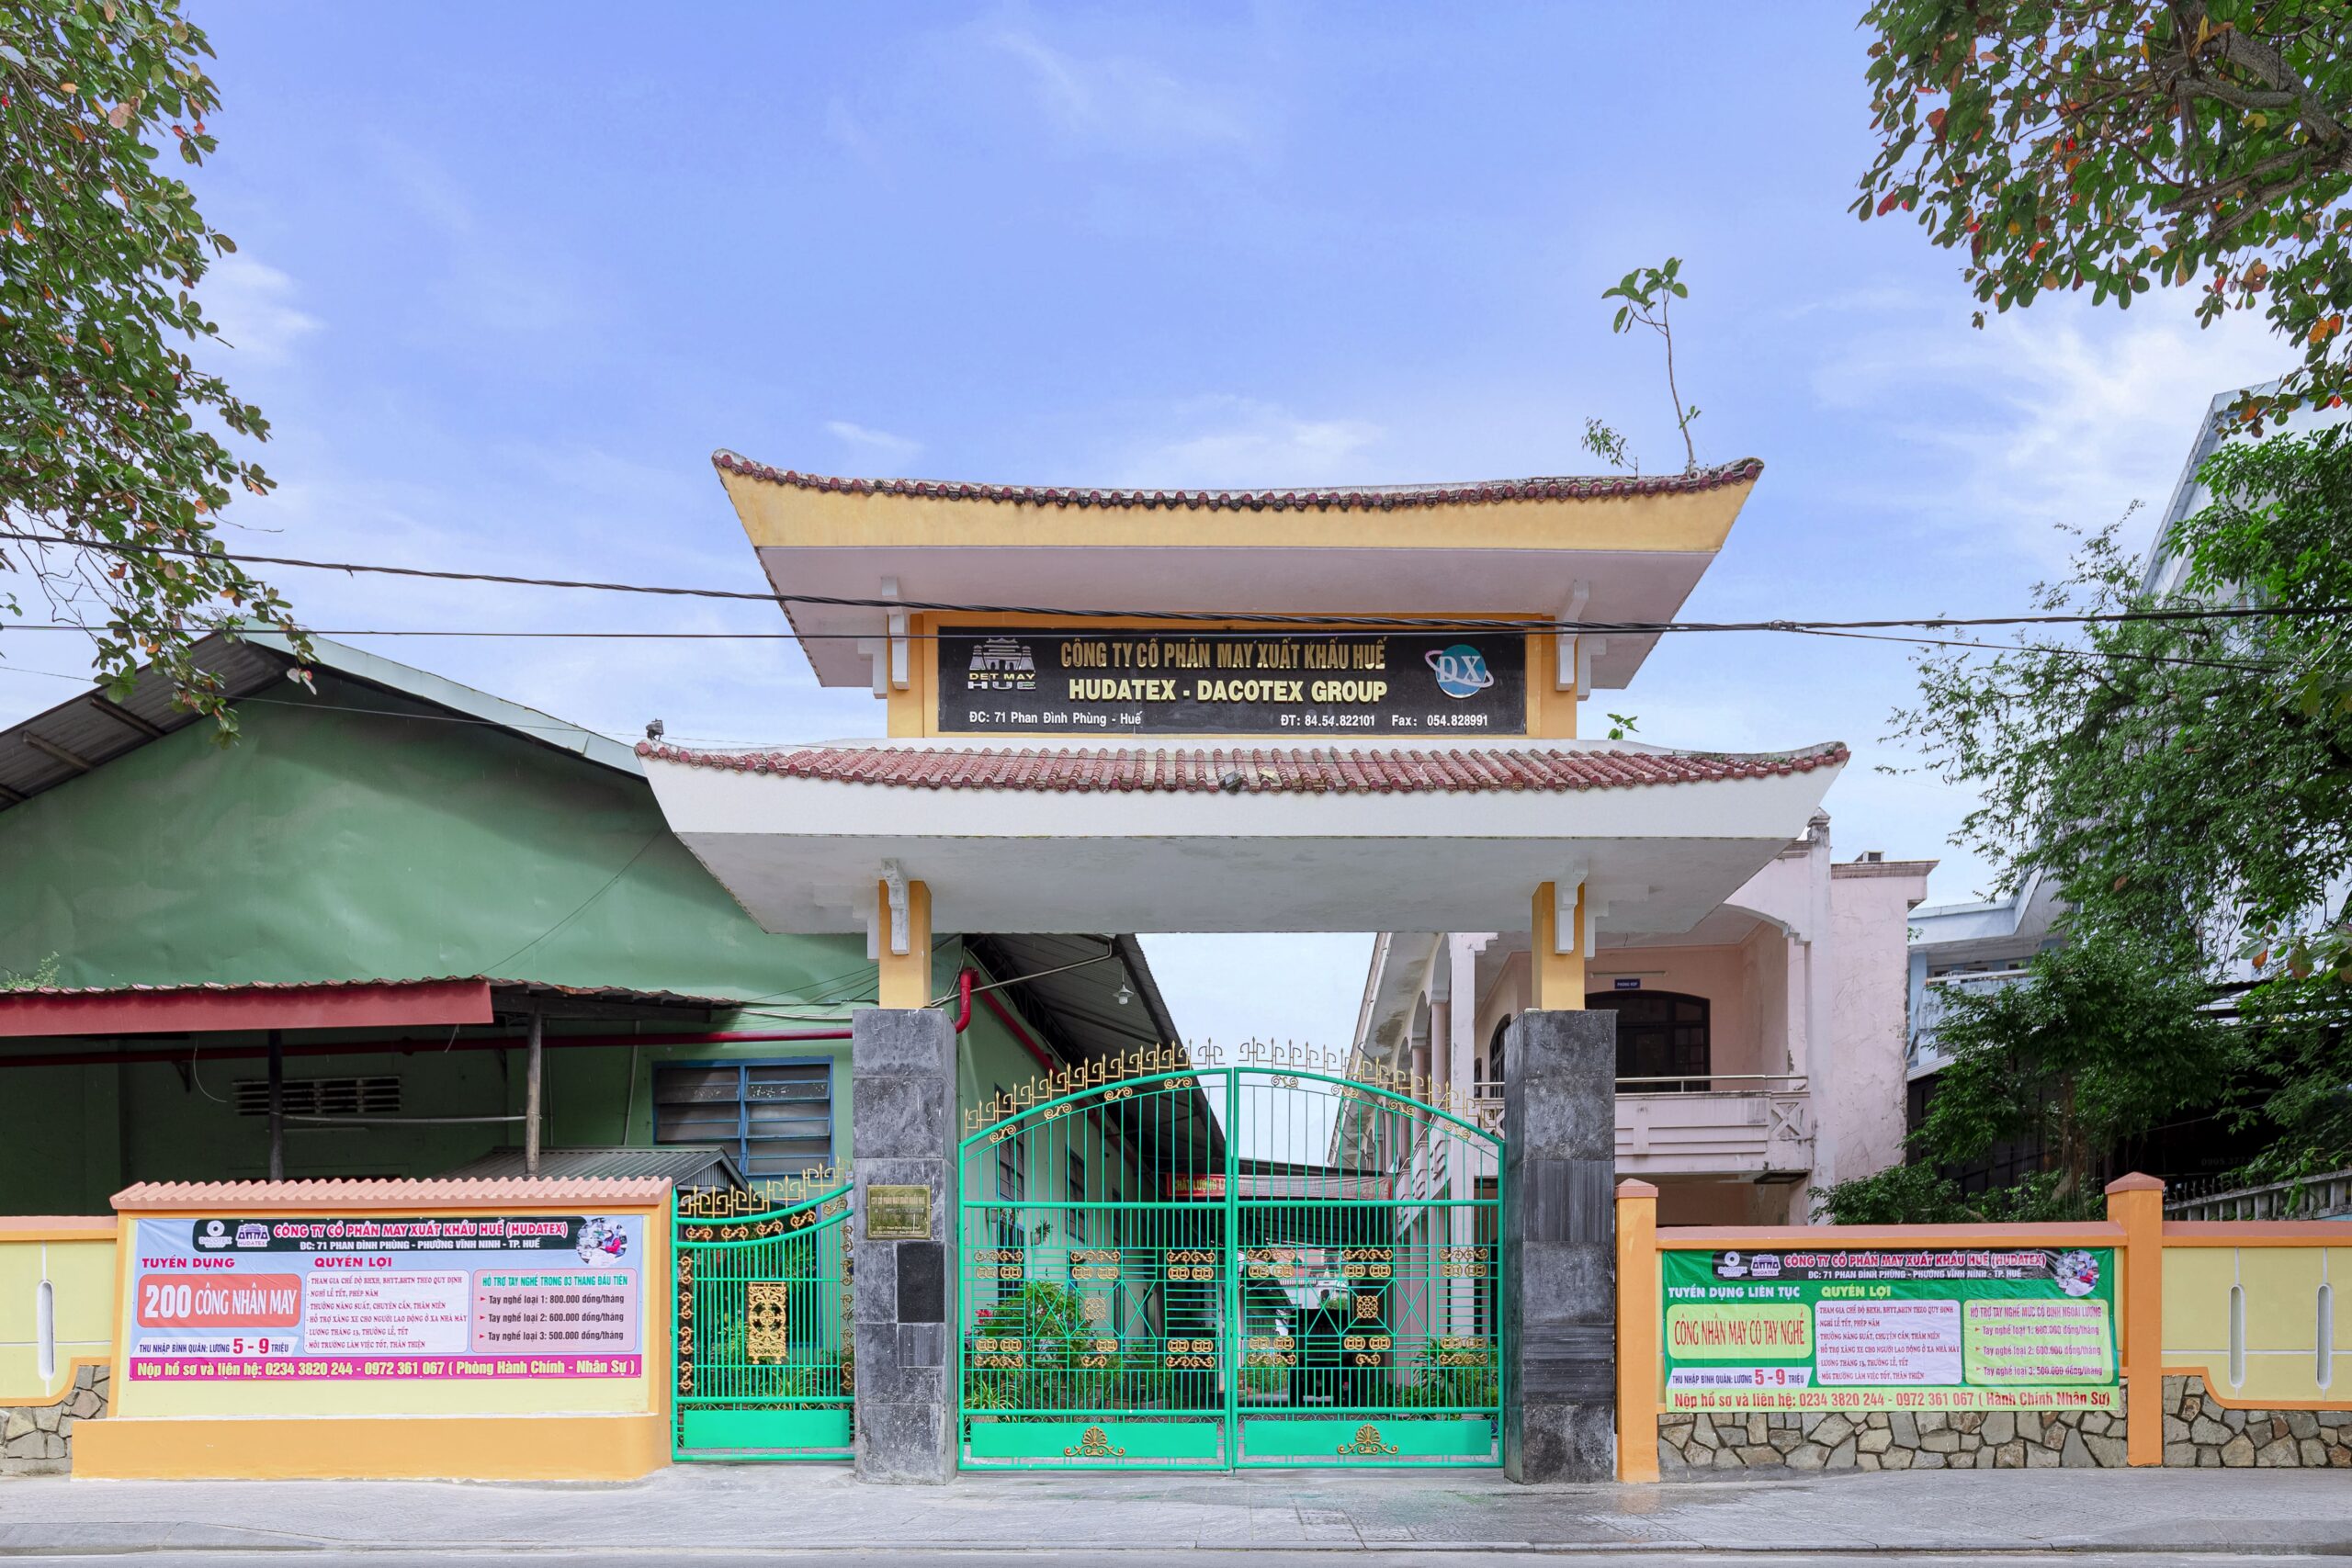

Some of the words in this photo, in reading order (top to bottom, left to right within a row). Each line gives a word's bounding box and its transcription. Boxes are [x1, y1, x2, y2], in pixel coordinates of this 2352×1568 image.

[1061, 637, 1107, 668] CÔNG
[1113, 643, 1133, 667] TY
[1217, 643, 1253, 668] MAY
[1257, 637, 1299, 669] XUẤT
[1353, 636, 1388, 669] HUẾ
[967, 681, 1036, 690] HUE
[1069, 679, 1176, 701] HUDATEX
[1197, 680, 1304, 702] DACOTEX
[1312, 681, 1387, 702] GROUP
[969, 711, 989, 723] ĐC:
[995, 712, 1006, 723] 71
[1011, 712, 1037, 724] Phan
[1043, 712, 1068, 724] Đình
[1073, 712, 1107, 727] Phùng
[1120, 711, 1143, 725] Huế
[1281, 715, 1301, 727] ĐT:
[1305, 715, 1374, 727] 84.54.822101
[1392, 715, 1418, 727] Fax:
[1427, 715, 1487, 727] 054.828991
[274, 1223, 309, 1237] CÔNG
[311, 1224, 326, 1237] TY
[381, 1224, 409, 1236] MAY
[409, 1220, 441, 1236] XUẤT
[479, 1217, 503, 1236] HUẾ
[506, 1222, 569, 1238] (HUDATEX)
[300, 1241, 315, 1250] ĐC:
[317, 1241, 327, 1250] 71
[330, 1241, 355, 1250] PHAN
[356, 1239, 378, 1250] ĐÌNH
[379, 1240, 410, 1249] PHÙNG
[417, 1239, 454, 1249] PHƯỜNG
[456, 1239, 477, 1248] VĨNH
[479, 1239, 501, 1248] NINH
[508, 1240, 521, 1248] TP.
[523, 1237, 541, 1248] HUẾ
[142, 1255, 187, 1269] TUYỂN
[193, 1258, 235, 1270] DỤNG
[369, 1258, 392, 1269] LỢI
[508, 1277, 518, 1286] TAY
[540, 1276, 561, 1286] TRONG
[564, 1276, 572, 1285] 03
[144, 1285, 192, 1318] 200
[195, 1282, 229, 1315] CÔNG
[232, 1281, 266, 1315] NHÂN
[269, 1289, 298, 1314] MAY
[489, 1295, 501, 1304] Tay
[541, 1295, 548, 1303] 1:
[550, 1295, 580, 1303] 800.000
[1709, 1286, 1745, 1301] DỤNG
[1748, 1284, 1775, 1298] LIÊN
[1778, 1286, 1800, 1301] TỤC
[1870, 1286, 1891, 1300] LỢI
[489, 1314, 501, 1323] Tay
[540, 1314, 548, 1322] 2:
[549, 1314, 580, 1322] 600.000
[1674, 1313, 1699, 1346] CÔNG
[1702, 1313, 1726, 1345] NHÂN
[1729, 1320, 1747, 1345] MAY
[1749, 1313, 1762, 1345] CÓ
[1764, 1320, 1779, 1345] TAY
[1781, 1308, 1804, 1345] NGHỀ
[488, 1332, 501, 1341] Tay
[539, 1332, 547, 1340] 3:
[548, 1332, 579, 1340] 500.000
[140, 1345, 152, 1353] THU
[153, 1343, 170, 1355] NHẬP
[172, 1342, 187, 1353] BÌNH
[188, 1343, 208, 1353] QUÂN:
[233, 1338, 243, 1354] 5
[258, 1338, 269, 1354] 9
[271, 1343, 288, 1355] TRIỆU
[138, 1362, 161, 1378] Nộp
[164, 1361, 180, 1375] hồ
[184, 1364, 198, 1375] sơ
[200, 1362, 216, 1375] và
[218, 1362, 240, 1375] liên
[243, 1362, 262, 1378] hệ:
[266, 1363, 295, 1375] 0234
[299, 1362, 328, 1375] 3820
[331, 1362, 353, 1375] 244
[364, 1362, 393, 1375] 0972
[397, 1362, 418, 1374] 361
[422, 1361, 445, 1374] 067
[456, 1361, 494, 1375] Phòng
[497, 1360, 527, 1374] Hành
[530, 1360, 565, 1374] Chính
[577, 1359, 607, 1373] Nhân
[611, 1359, 628, 1376] Sự
[1673, 1375, 1683, 1383] THU
[1684, 1374, 1699, 1385] NHẬP
[1702, 1373, 1714, 1383] BÌNH
[1715, 1373, 1733, 1384] QUÂN:
[1755, 1370, 1764, 1385] 5
[1776, 1369, 1785, 1385] 9
[1788, 1373, 1804, 1385] TRIỆU
[1675, 1393, 1697, 1409] Nộp
[1701, 1392, 1715, 1406] hồ
[1719, 1394, 1732, 1406] sơ
[1736, 1393, 1749, 1406] và
[1753, 1393, 1775, 1406] liên
[1779, 1393, 1796, 1409] hệ:
[1800, 1393, 1827, 1406] 0234
[1832, 1393, 1860, 1406] 3820
[1863, 1393, 1883, 1405] 244
[1896, 1393, 1925, 1405] 0972
[1928, 1393, 1948, 1405] 361
[1953, 1393, 1974, 1405] 067
[1987, 1392, 2016, 1405] Hành
[2019, 1392, 2053, 1405] Chính
[2057, 1392, 2087, 1405] Nhân
